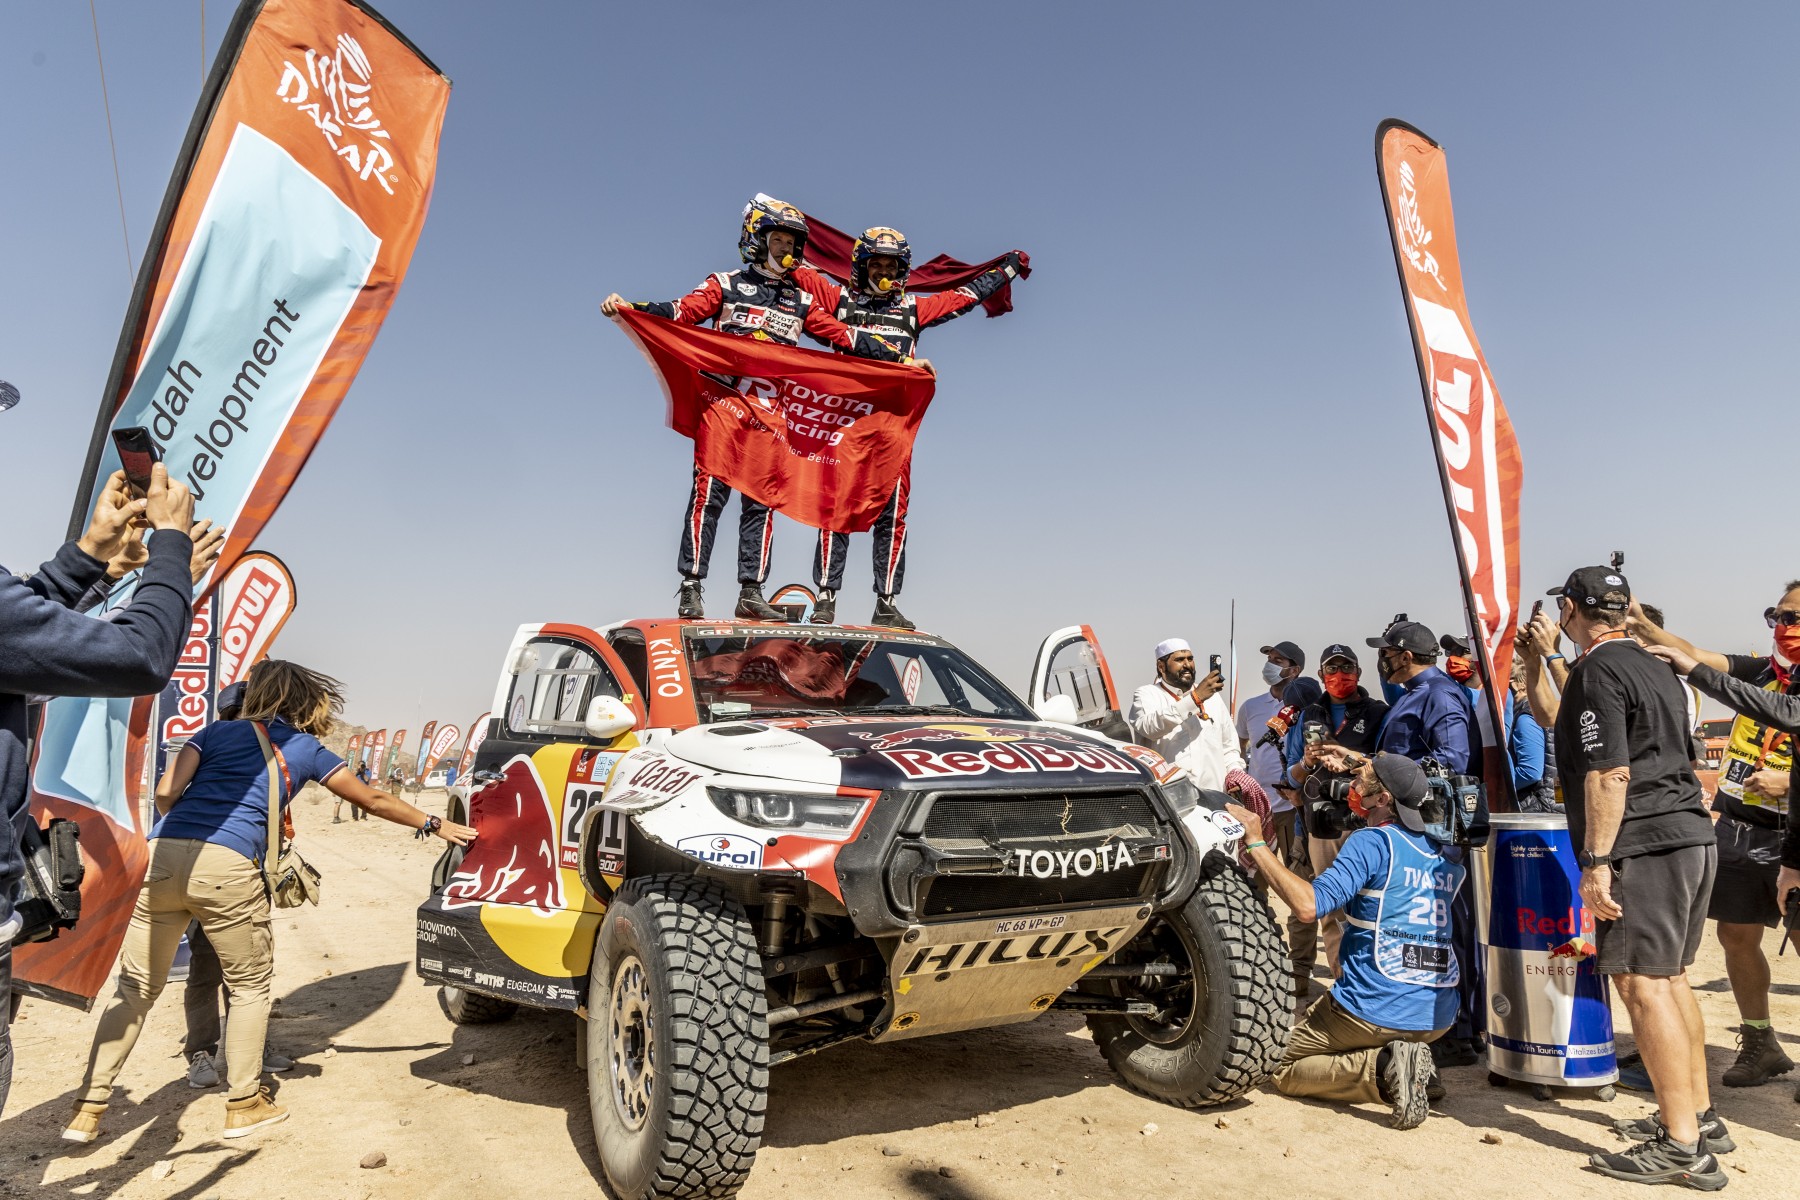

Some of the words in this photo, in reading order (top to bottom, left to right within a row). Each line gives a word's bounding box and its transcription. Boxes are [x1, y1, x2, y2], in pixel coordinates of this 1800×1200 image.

[276, 61, 394, 195] DAKAR
[732, 309, 763, 326] GR
[151, 359, 203, 455] dah
[187, 298, 300, 501] velopment
[783, 379, 873, 416] TOYOTA
[702, 390, 745, 419] Pushing
[750, 417, 768, 432] the
[807, 452, 841, 466] Better
[220, 576, 275, 692] MOTUL
[698, 628, 732, 636] GR
[738, 628, 813, 636] TOYOTA
[817, 631, 879, 639] GAZOO
[882, 635, 937, 646] Racing
[163, 668, 208, 743] Red
[434, 728, 457, 756] MOTUL
[882, 742, 1035, 778] Red
[1016, 743, 1140, 774] Bull
[629, 759, 703, 795] Qatar
[1222, 824, 1244, 835] eur
[599, 859, 624, 873] 300V
[1015, 841, 1134, 879] TOYOTA
[1404, 867, 1422, 888] TV
[996, 921, 1010, 933] HC
[1013, 919, 1026, 931] 68
[1028, 918, 1042, 930] WP
[1050, 916, 1065, 928] GP
[1409, 896, 1448, 927] 28
[1517, 906, 1576, 935] Red
[903, 927, 1127, 976] HILUX
[507, 980, 545, 994] EDGECAM
[1536, 1045, 1565, 1056] Taurine.
